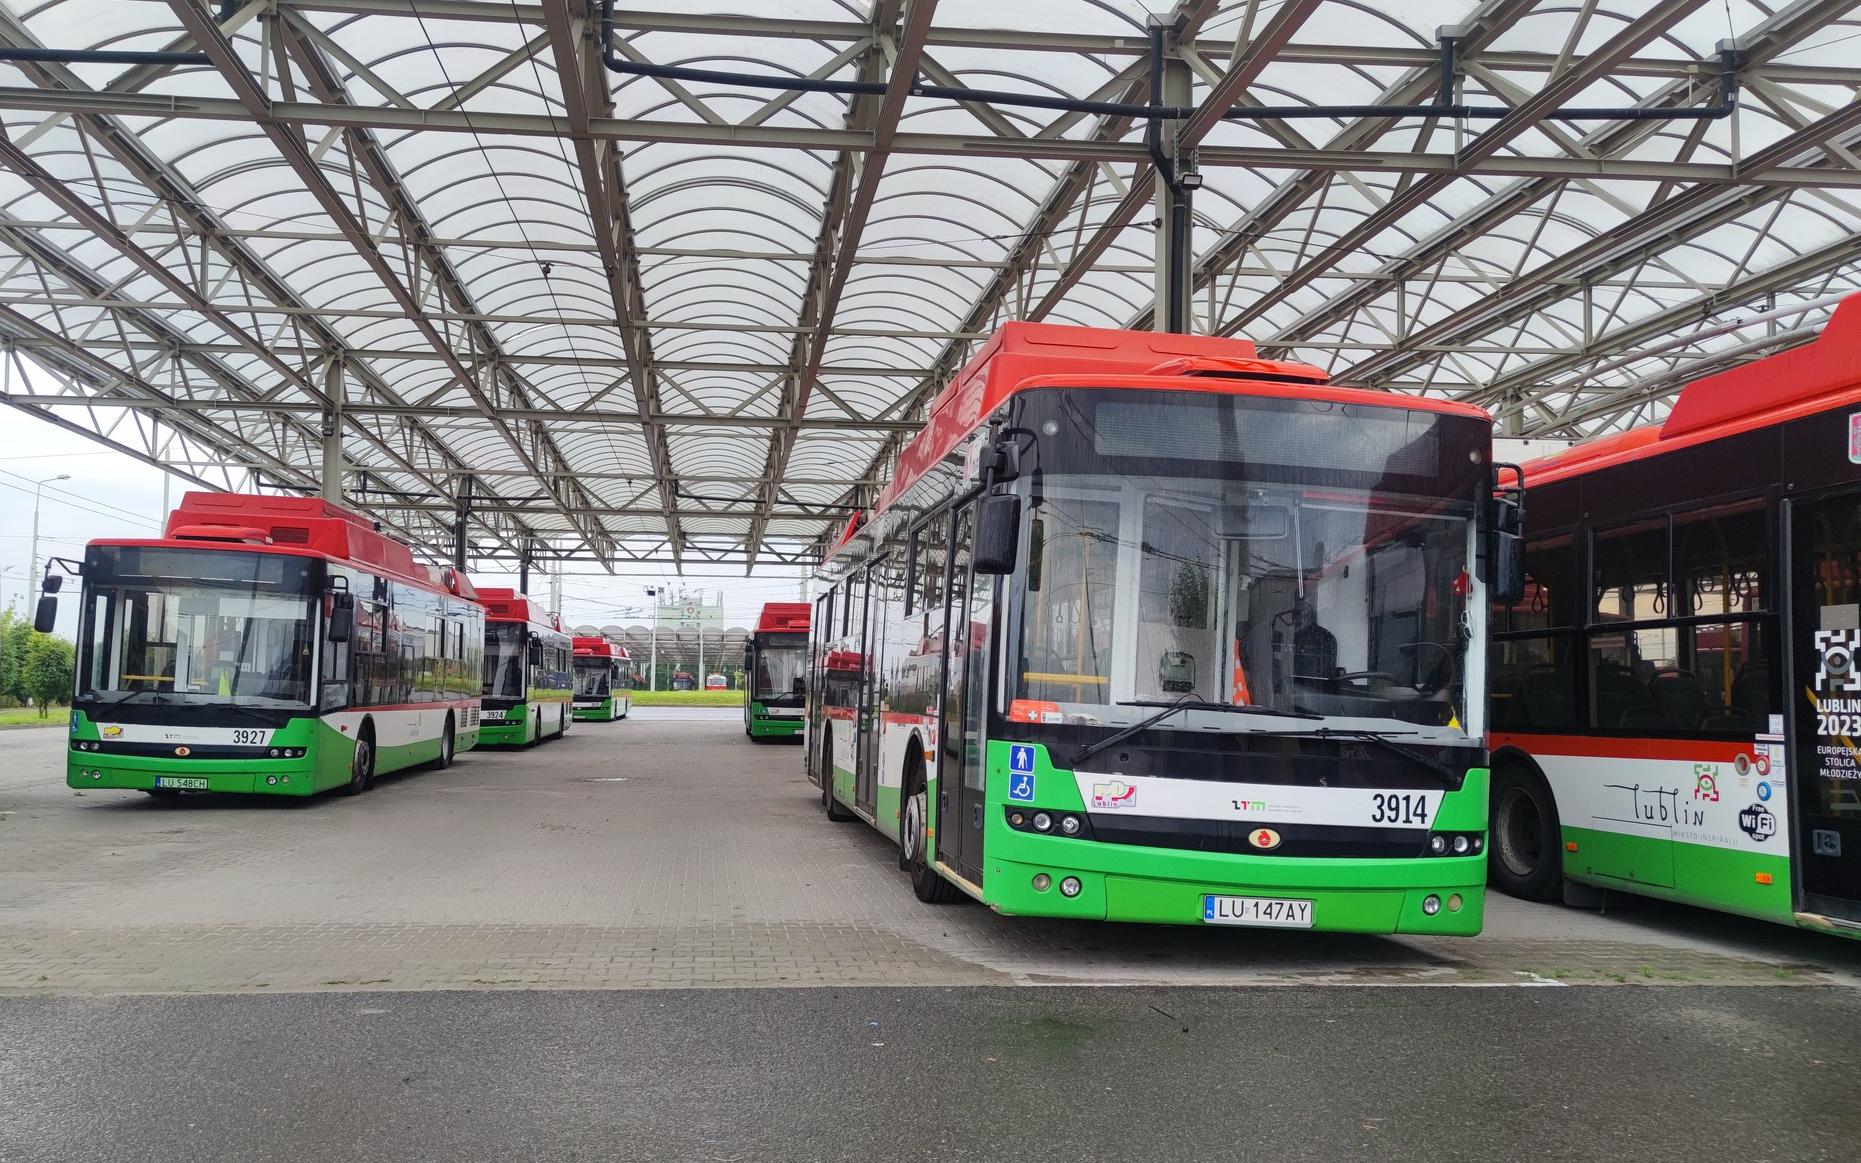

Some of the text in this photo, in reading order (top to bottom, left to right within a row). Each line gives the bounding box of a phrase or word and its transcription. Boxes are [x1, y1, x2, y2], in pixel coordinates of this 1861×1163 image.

[1816, 698, 1861, 713] LUBLIN
[486, 711, 504, 719] 3924
[1817, 714, 1861, 737] 2023
[233, 730, 266, 745] 3927
[1825, 757, 1856, 767] STOLICA
[162, 778, 206, 788] LU 548CH
[1371, 793, 1428, 825] 3914
[1752, 804, 1765, 812] Free
[1219, 899, 1308, 921] LU 147AY
